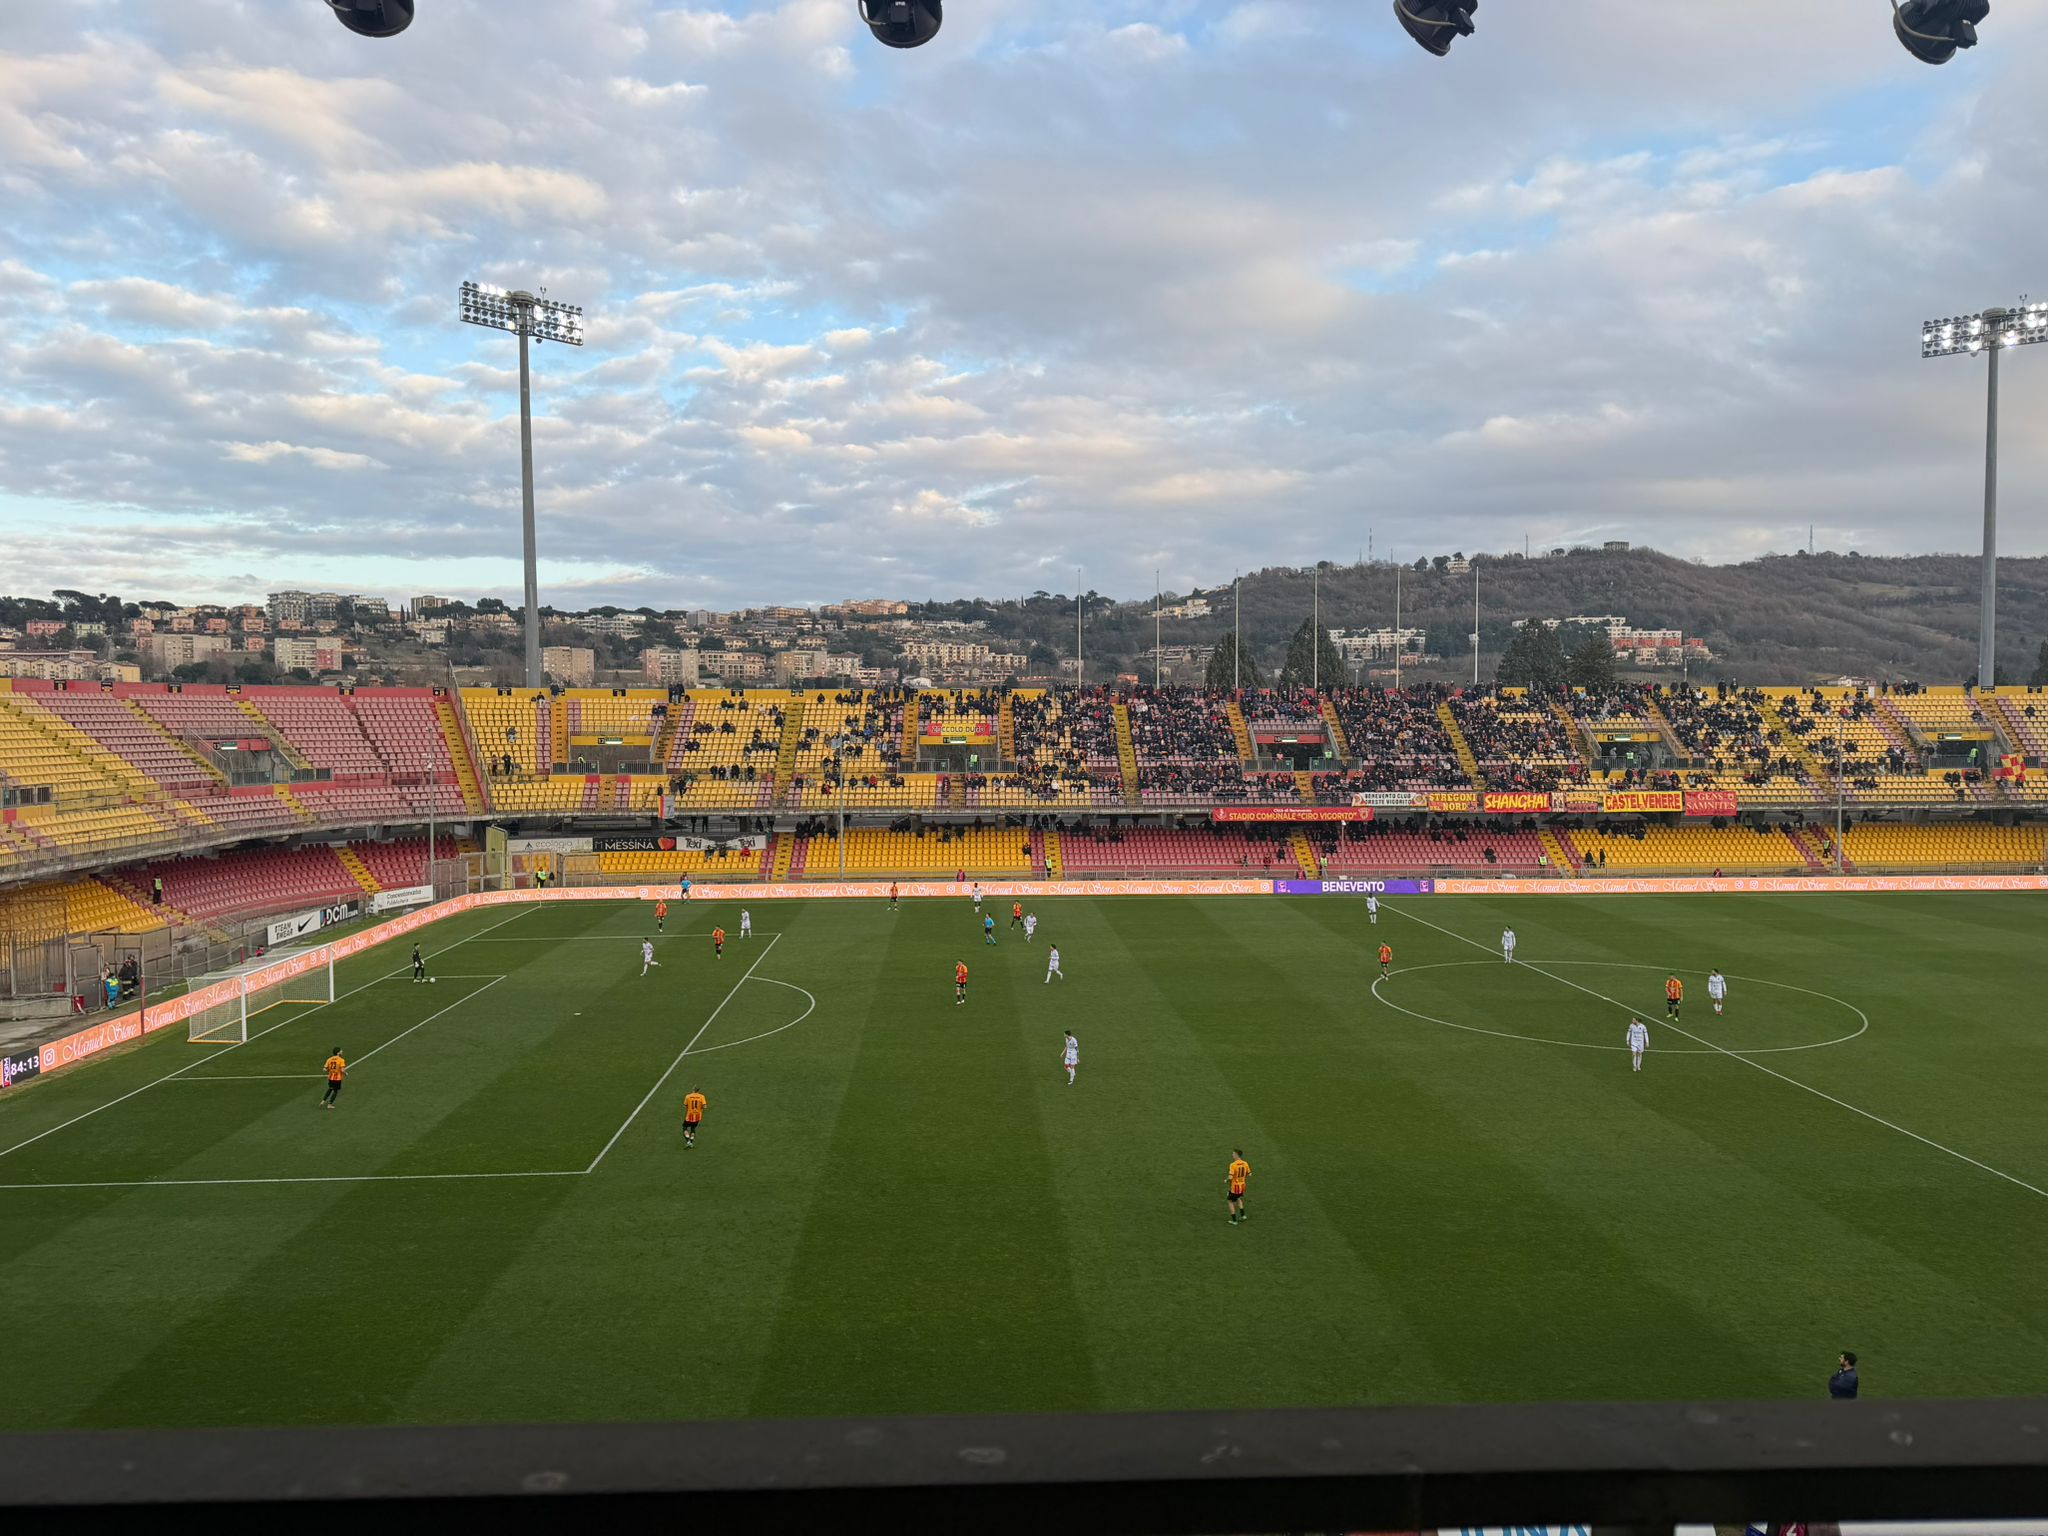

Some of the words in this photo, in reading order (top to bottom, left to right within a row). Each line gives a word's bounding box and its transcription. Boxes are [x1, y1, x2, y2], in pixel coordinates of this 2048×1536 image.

[1429, 793, 1477, 802] STREGONI
[1485, 793, 1548, 810] SHANGHAI
[1605, 793, 1681, 810] CASTELVENERE
[1697, 792, 1723, 801] GENS
[1442, 802, 1468, 811] NORD
[1686, 801, 1736, 810] SAMNITES
[1229, 812, 1255, 820] STADIO
[1256, 812, 1297, 821] COMUNALE
[605, 841, 655, 850] MESSINA
[1048, 883, 1086, 895] Manuel
[1086, 882, 1115, 895] Store
[1322, 881, 1385, 892] BENEVENTO
[63, 1028, 105, 1060] Manuel
[107, 1022, 137, 1043] Store
[11, 1055, 39, 1076] 84:13
